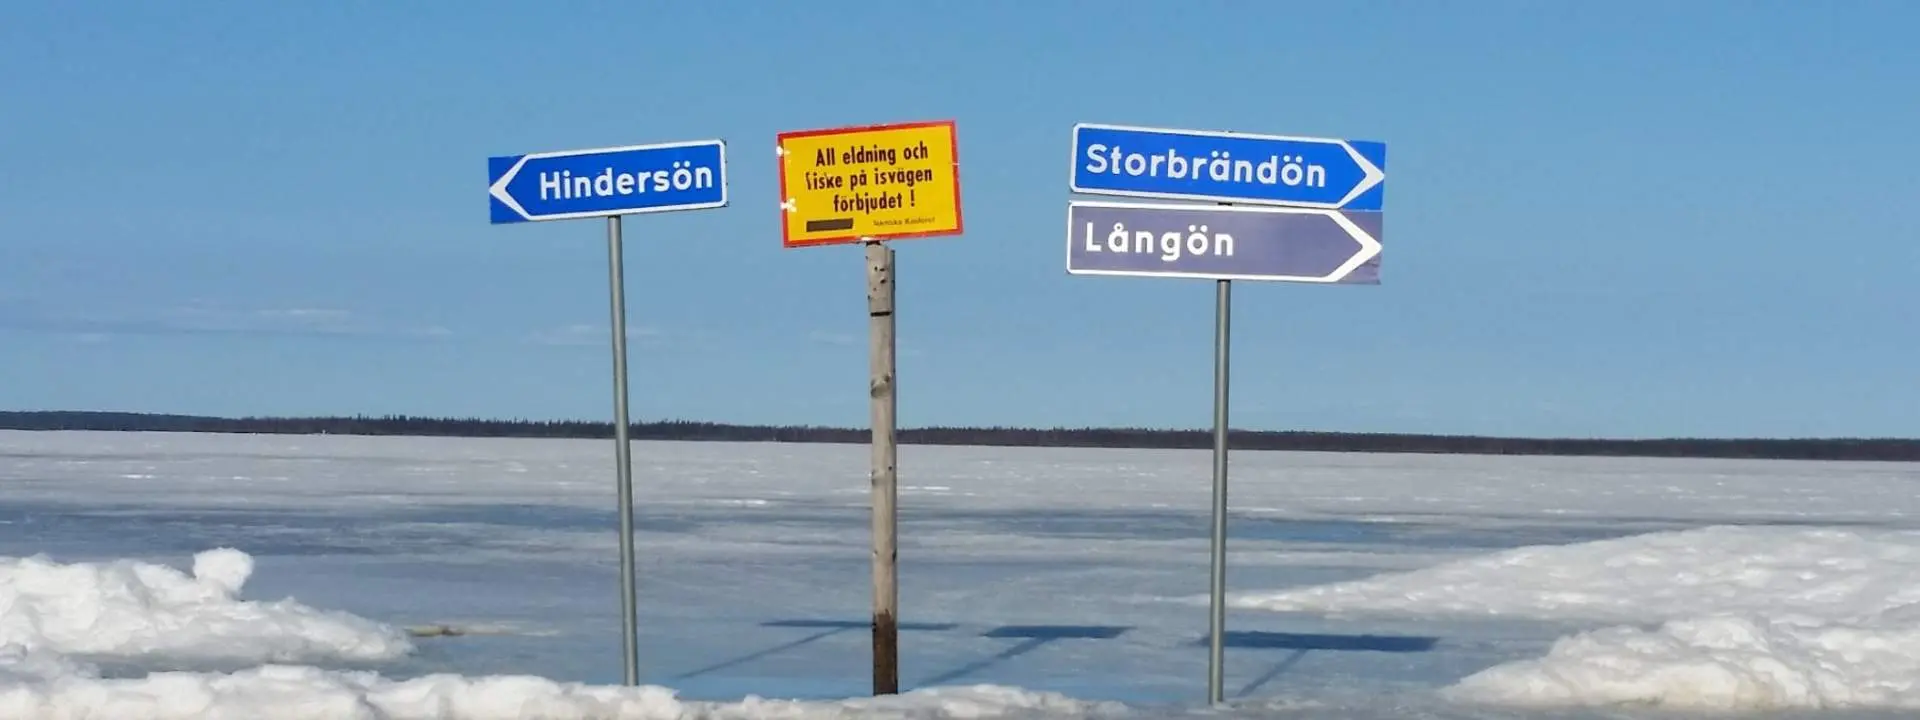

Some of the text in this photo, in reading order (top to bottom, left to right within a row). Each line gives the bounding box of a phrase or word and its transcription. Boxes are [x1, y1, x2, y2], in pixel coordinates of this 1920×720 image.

[815, 140, 929, 167] All eldning och
[1086, 143, 1326, 188] Storbrändön
[540, 160, 713, 200] Hindersön
[850, 169, 867, 191] på
[874, 167, 933, 187] isvägen
[833, 191, 902, 215] förbjudet
[1085, 221, 1234, 262] Långön
